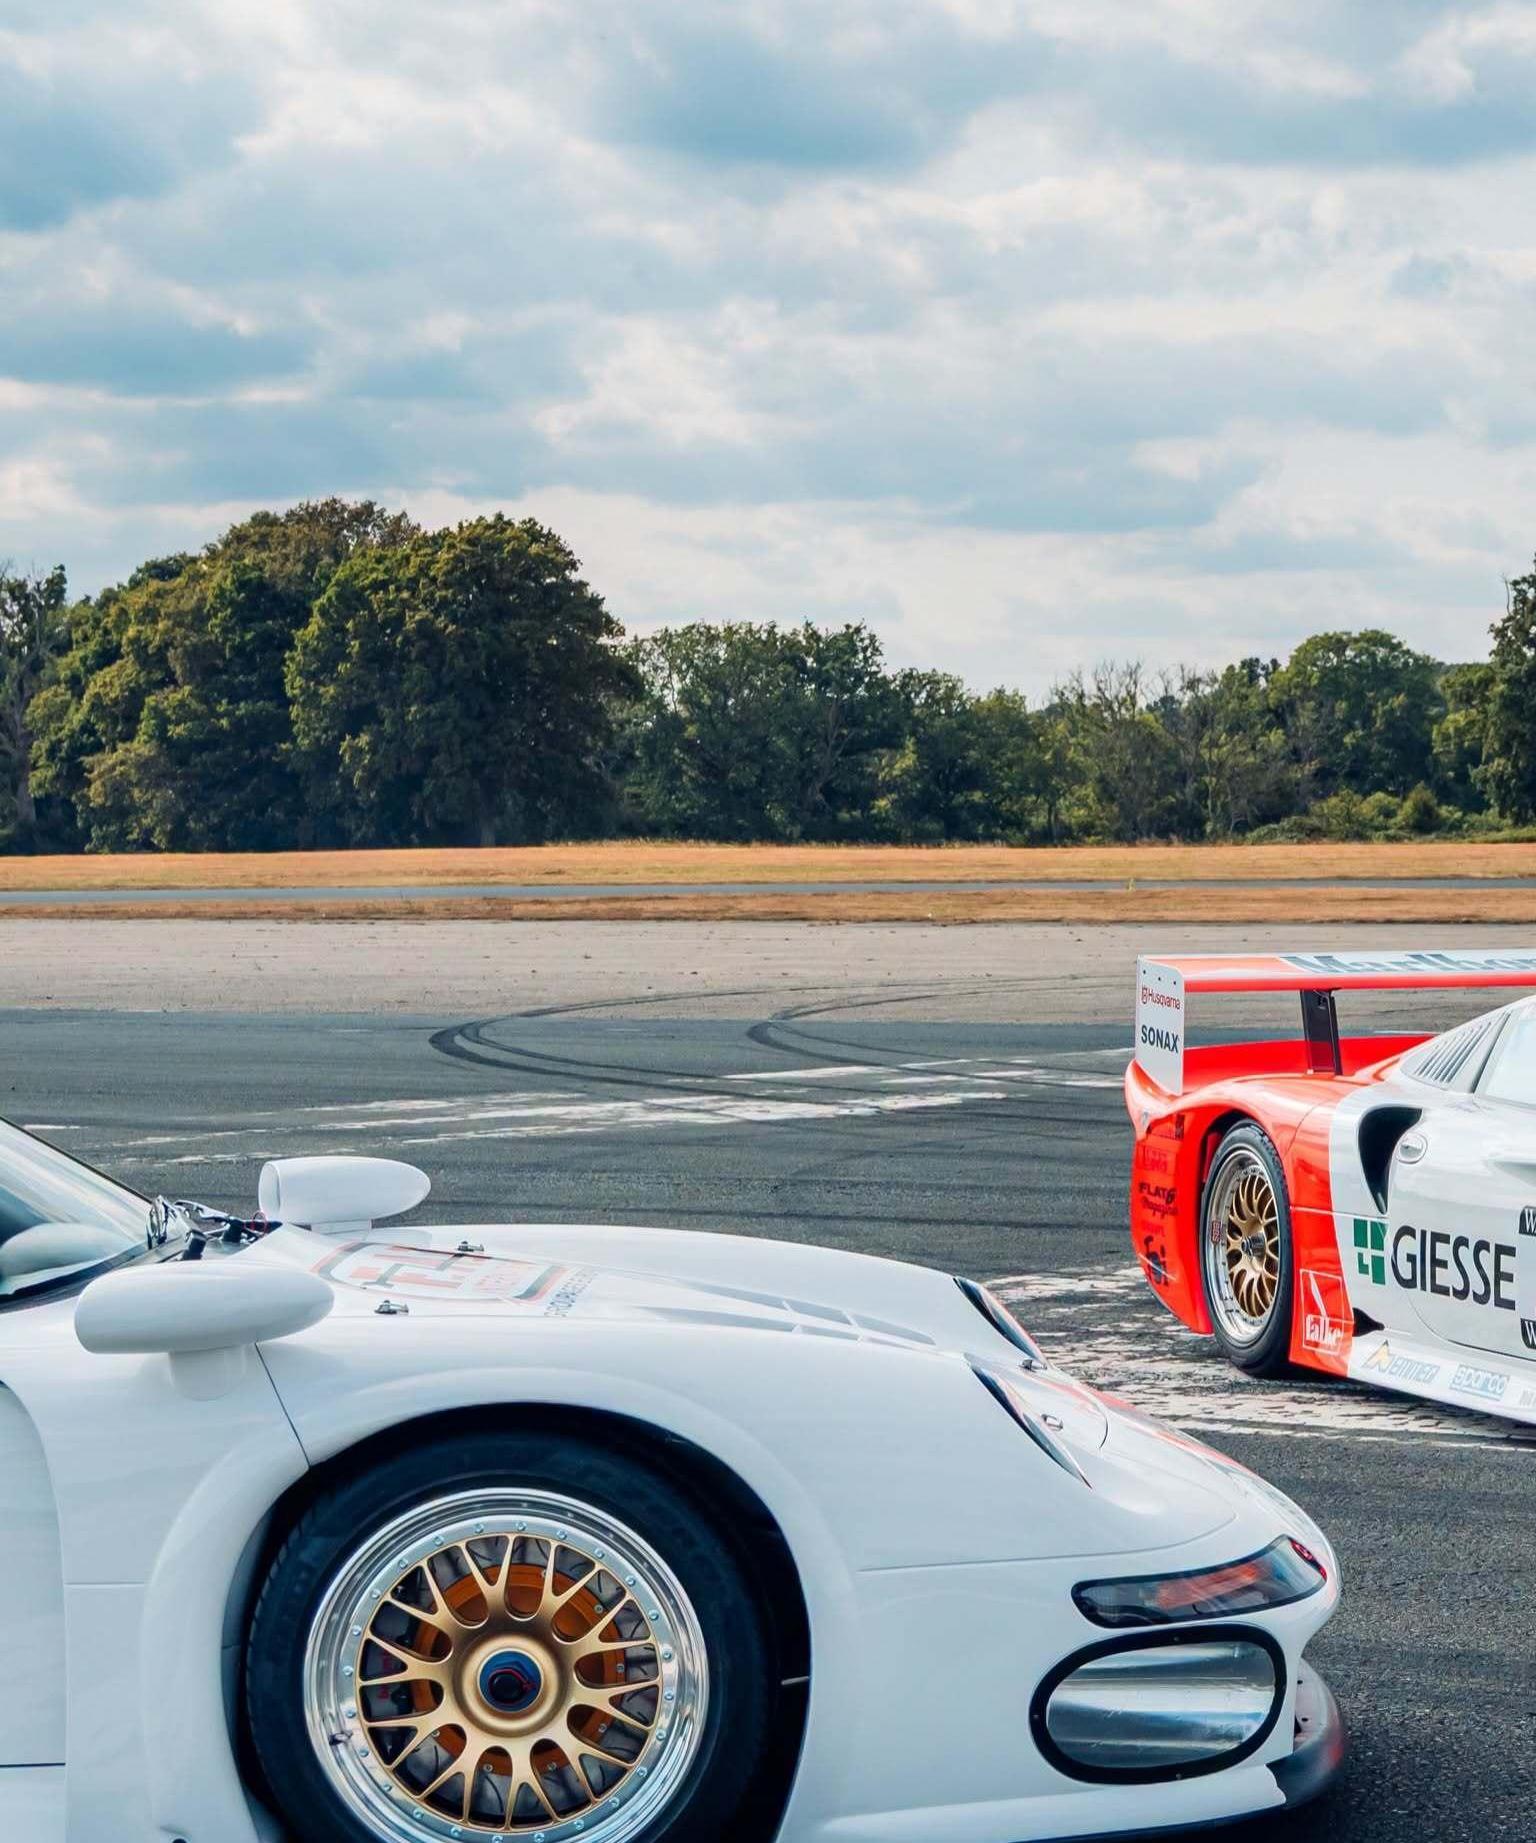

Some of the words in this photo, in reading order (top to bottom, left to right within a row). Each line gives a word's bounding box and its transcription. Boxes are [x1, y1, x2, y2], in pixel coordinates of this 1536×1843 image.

[1141, 1024, 1179, 1053] SONAX
[1391, 1226, 1516, 1311] GIESSE
[1453, 1366, 1506, 1394] sparco
